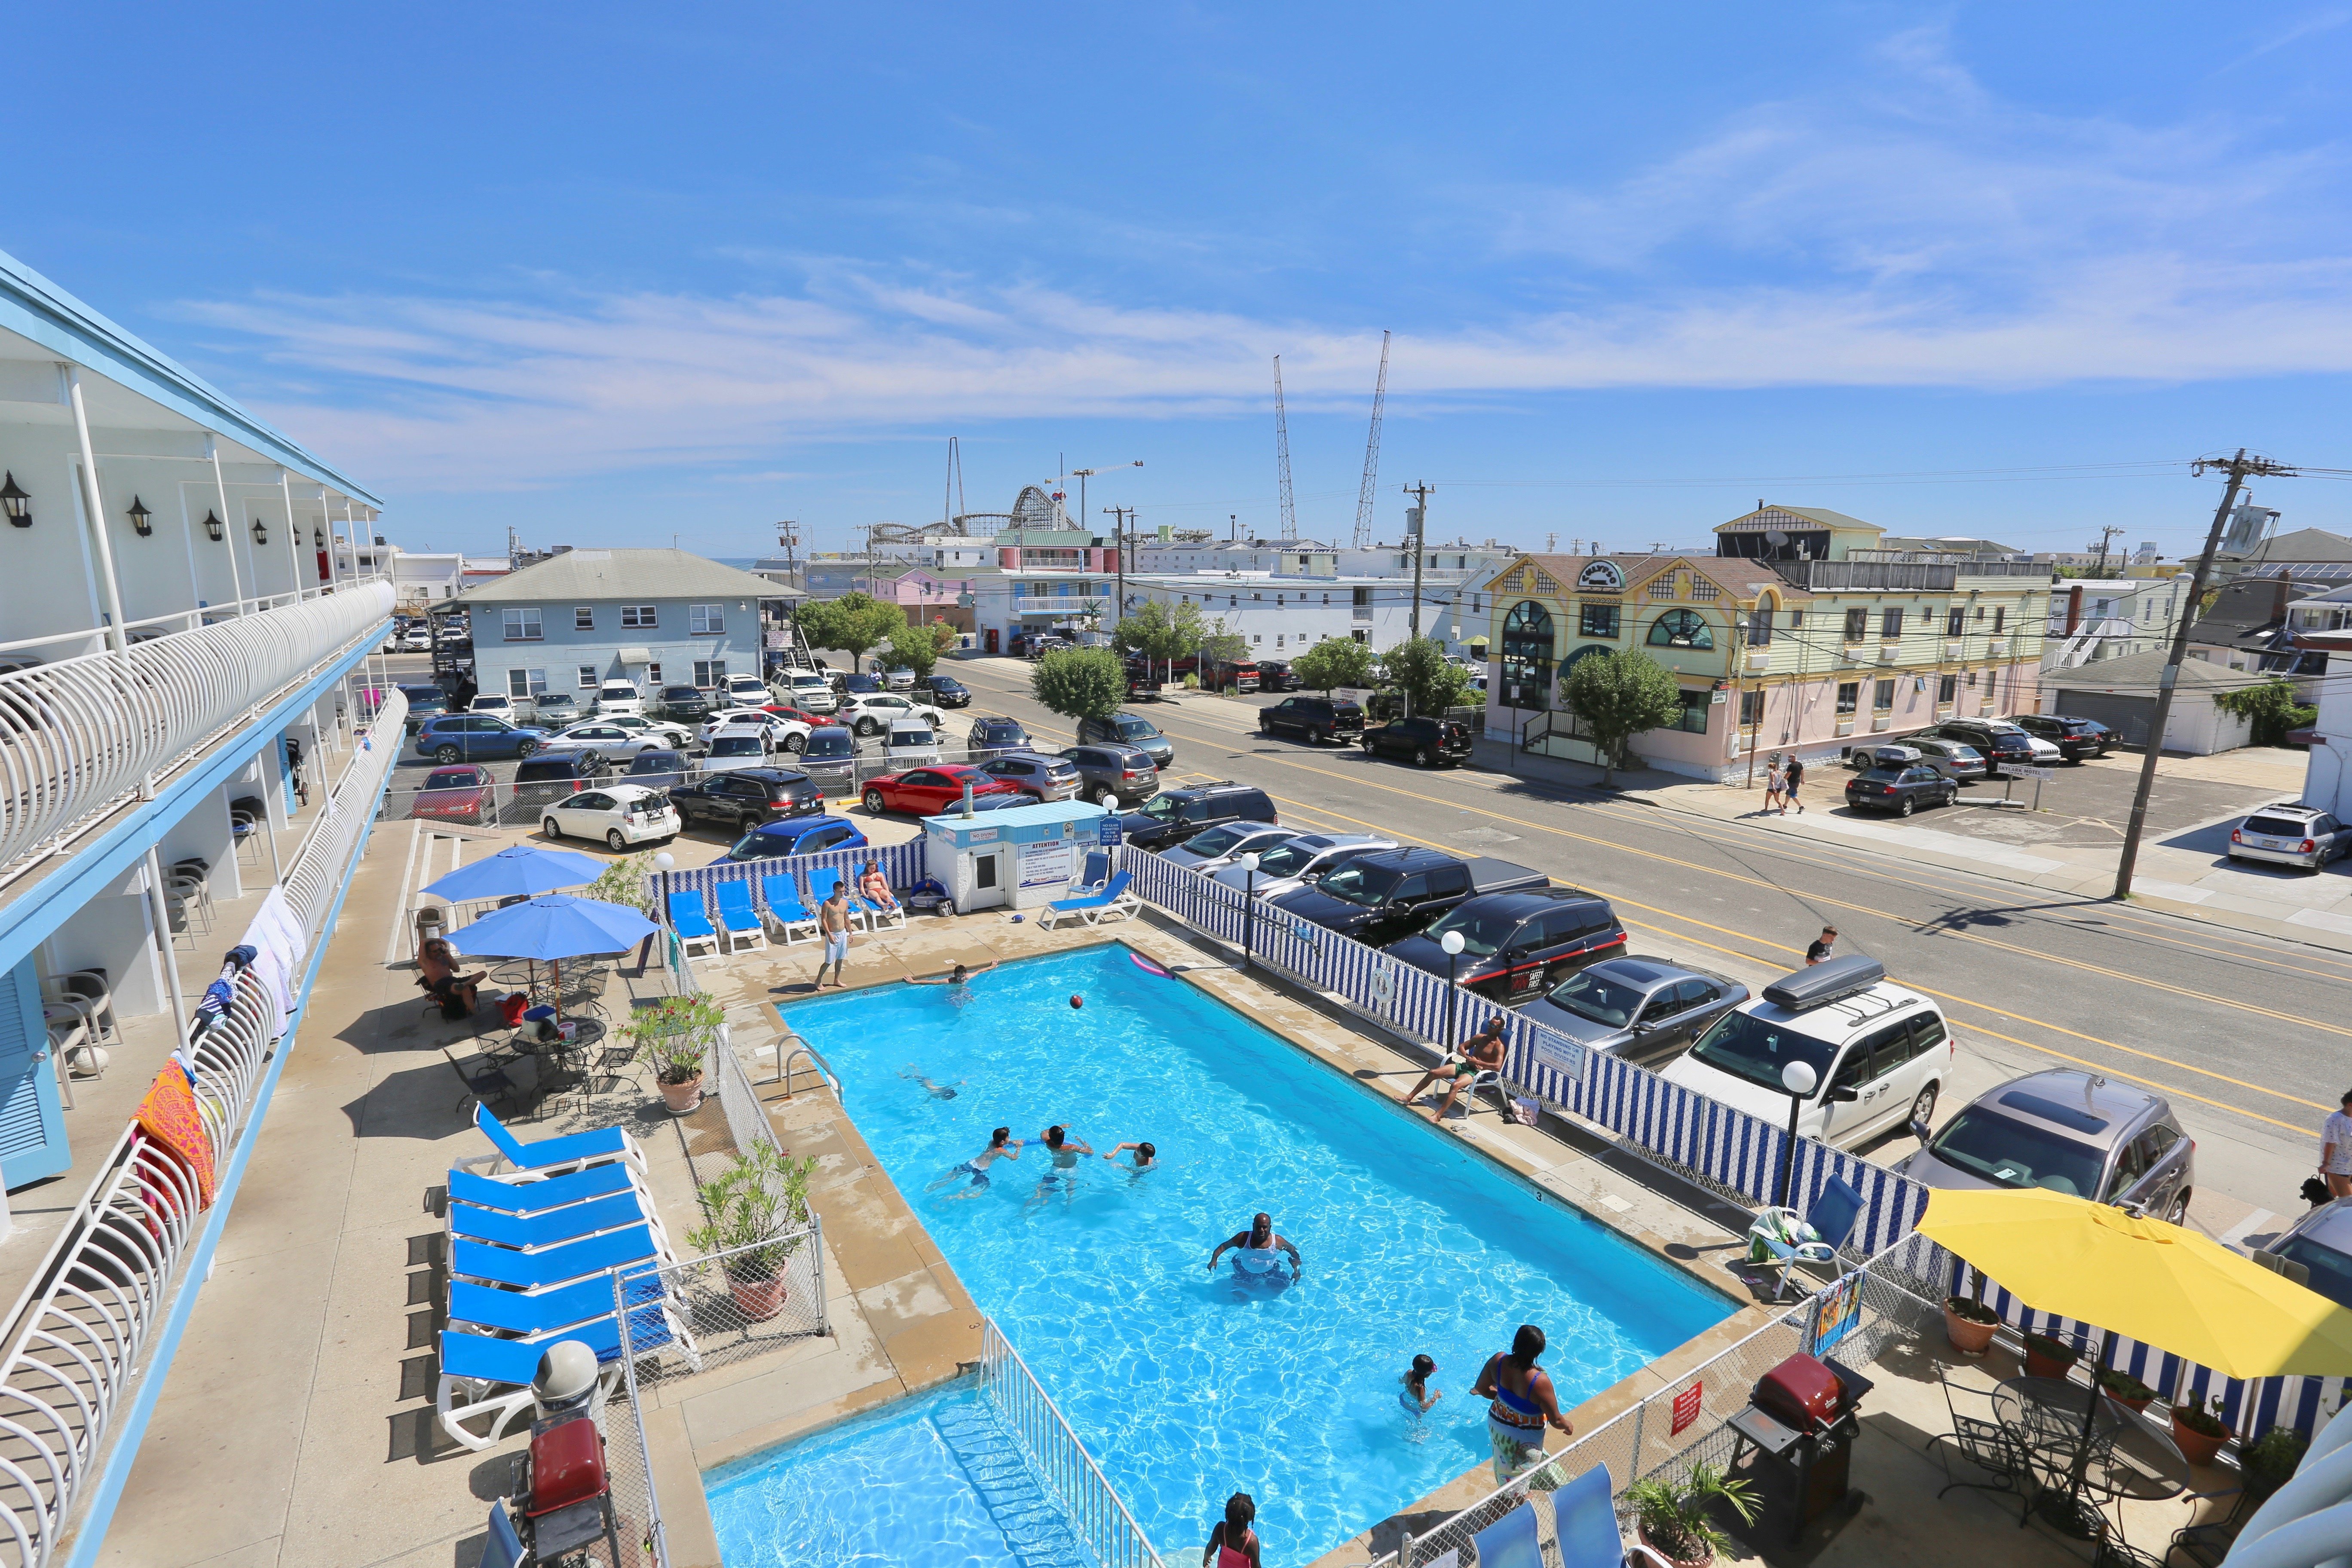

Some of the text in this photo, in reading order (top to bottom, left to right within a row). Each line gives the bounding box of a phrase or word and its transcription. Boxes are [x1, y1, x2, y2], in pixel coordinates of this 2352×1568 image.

[1529, 971, 1544, 981] SAFETY
[1528, 979, 1540, 989] FIRST
[1548, 1037, 1571, 1050] STANDING
[1543, 1041, 1575, 1058] PLAYING WITH
[1541, 1046, 1576, 1065] POOL DIVIDERS
[1536, 1191, 1542, 1202] 3
[1687, 1387, 1697, 1396] Grills
[1680, 1394, 1697, 1409] Available
[1679, 1406, 1689, 1415] Noon
[1678, 1412, 1689, 1421] Clean
